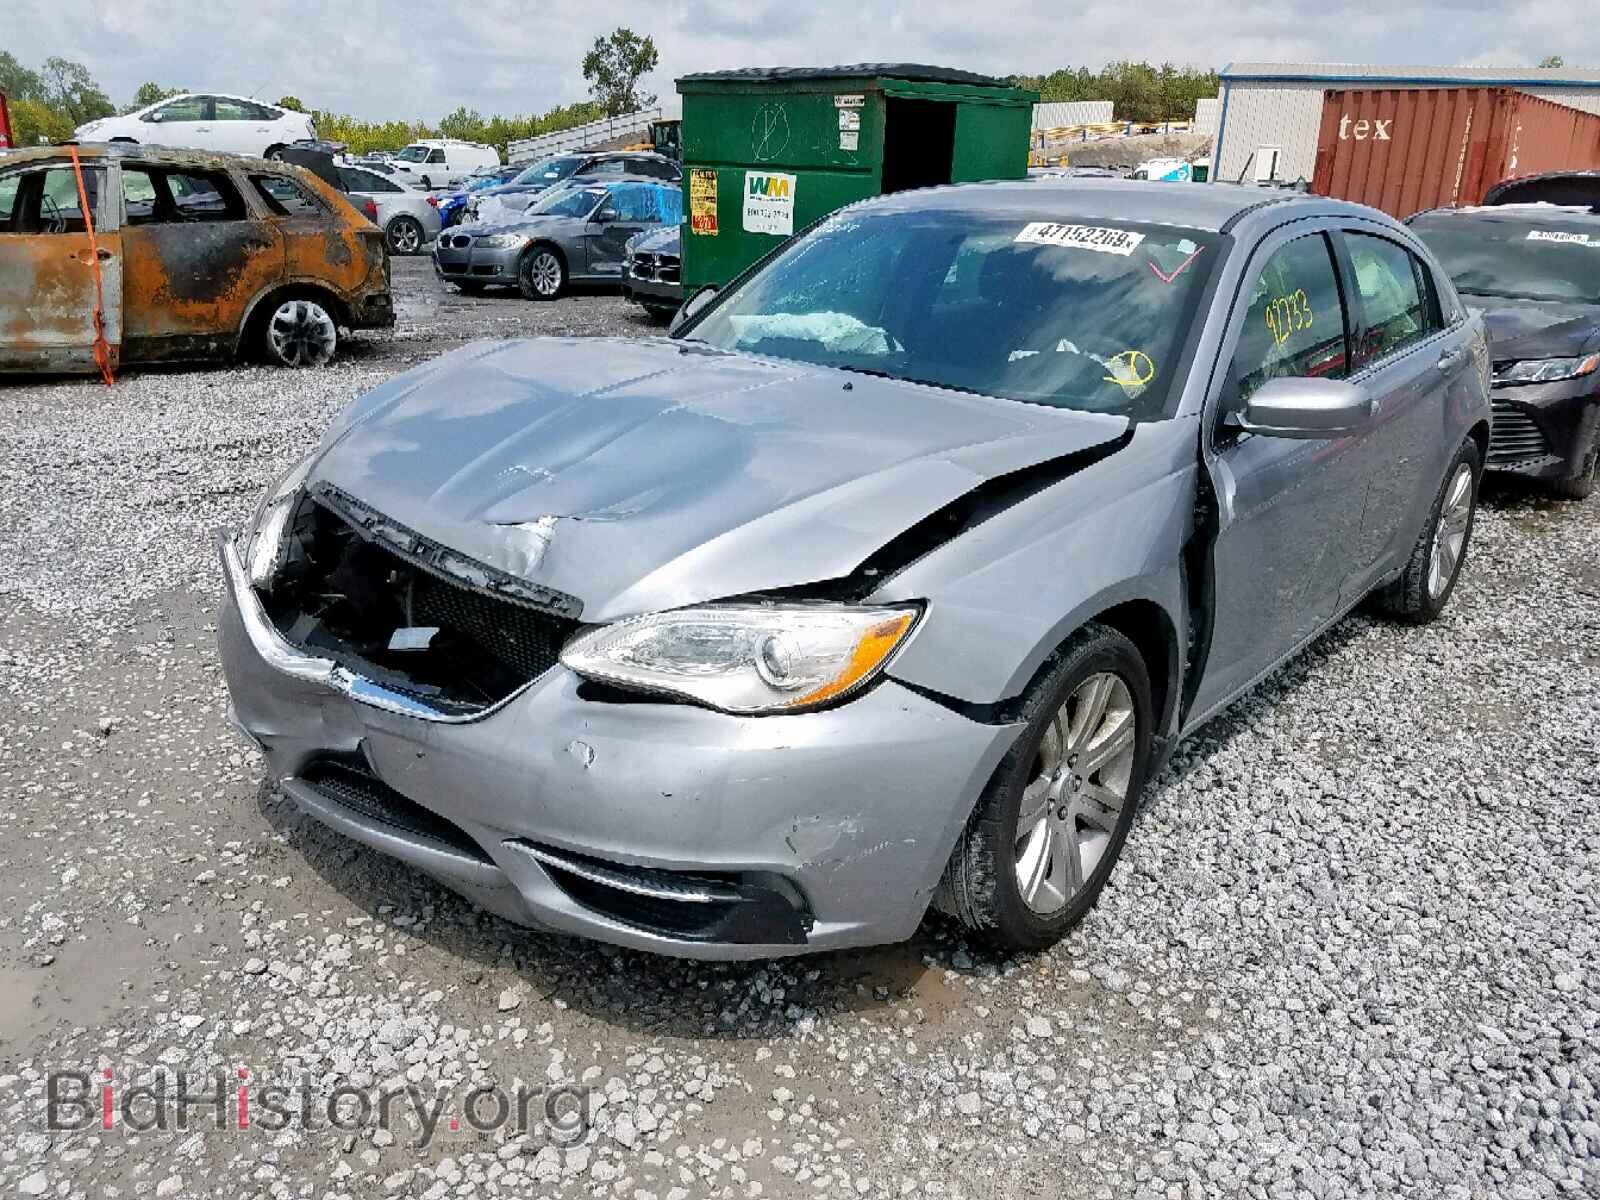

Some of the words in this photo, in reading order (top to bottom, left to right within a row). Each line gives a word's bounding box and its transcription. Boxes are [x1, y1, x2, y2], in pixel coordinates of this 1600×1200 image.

[1338, 113, 1393, 140] tex
[749, 176, 789, 196] WM
[1265, 288, 1313, 345] 92733
